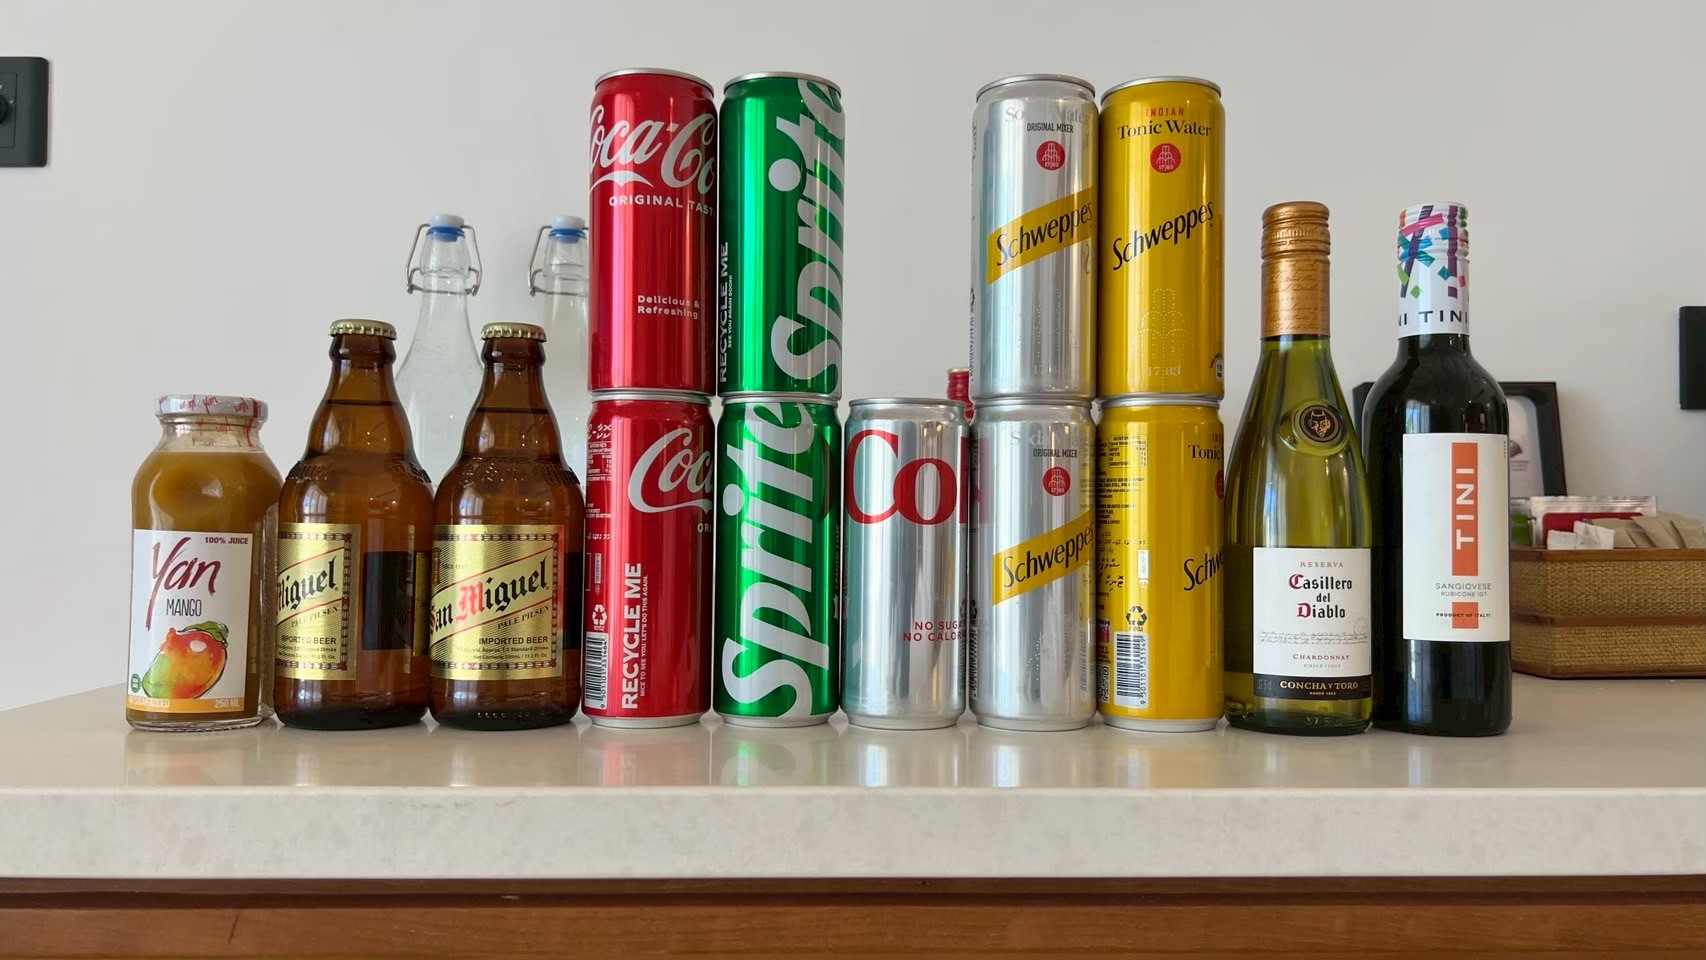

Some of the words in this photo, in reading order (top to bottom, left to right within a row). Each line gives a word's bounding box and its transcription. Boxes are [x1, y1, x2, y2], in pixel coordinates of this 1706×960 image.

[1146, 107, 1185, 118] INDIAN
[1027, 122, 1055, 132] ORIGINAL
[1056, 123, 1074, 133] MIXER
[1117, 123, 1163, 141] Tonic
[1165, 119, 1212, 138] Water
[609, 194, 683, 209] ORIGINAL
[768, 78, 845, 395] Sprite
[996, 201, 1094, 267] Schweppes
[1112, 201, 1214, 271] Schweppes
[720, 241, 729, 277] ME
[637, 295, 692, 308] Delicious
[693, 300, 700, 308] &
[637, 305, 699, 320] Refreshing
[1418, 309, 1468, 324] TINI
[720, 281, 729, 383] RECYCLE
[1033, 448, 1061, 458] ORIGINAL
[1062, 449, 1078, 458] MIXER
[1456, 467, 1475, 551] TINI
[204, 536, 226, 545] 100%
[227, 536, 249, 545] JUICE
[722, 402, 829, 718] Sprite
[1003, 519, 1096, 588] Schweppes
[145, 537, 222, 631] Yan
[624, 563, 641, 598] ME
[1288, 573, 1353, 590] Casillero
[1434, 582, 1492, 590] SANGIOVESE
[456, 555, 548, 623] Miguel
[1316, 593, 1331, 603] del
[166, 598, 202, 617] MANGO
[521, 605, 550, 622] PILSEN
[1296, 602, 1346, 619] Diablo
[642, 612, 648, 623] DO
[914, 621, 933, 631] NO
[313, 637, 337, 645] BEER
[478, 637, 524, 645] IMPORTED
[526, 636, 549, 644] BEER
[902, 632, 923, 642] NO
[622, 603, 640, 709] RECYCLE
[640, 671, 646, 681] TO
[1279, 680, 1327, 690] CONCHA
[1334, 681, 1359, 690] TORO
